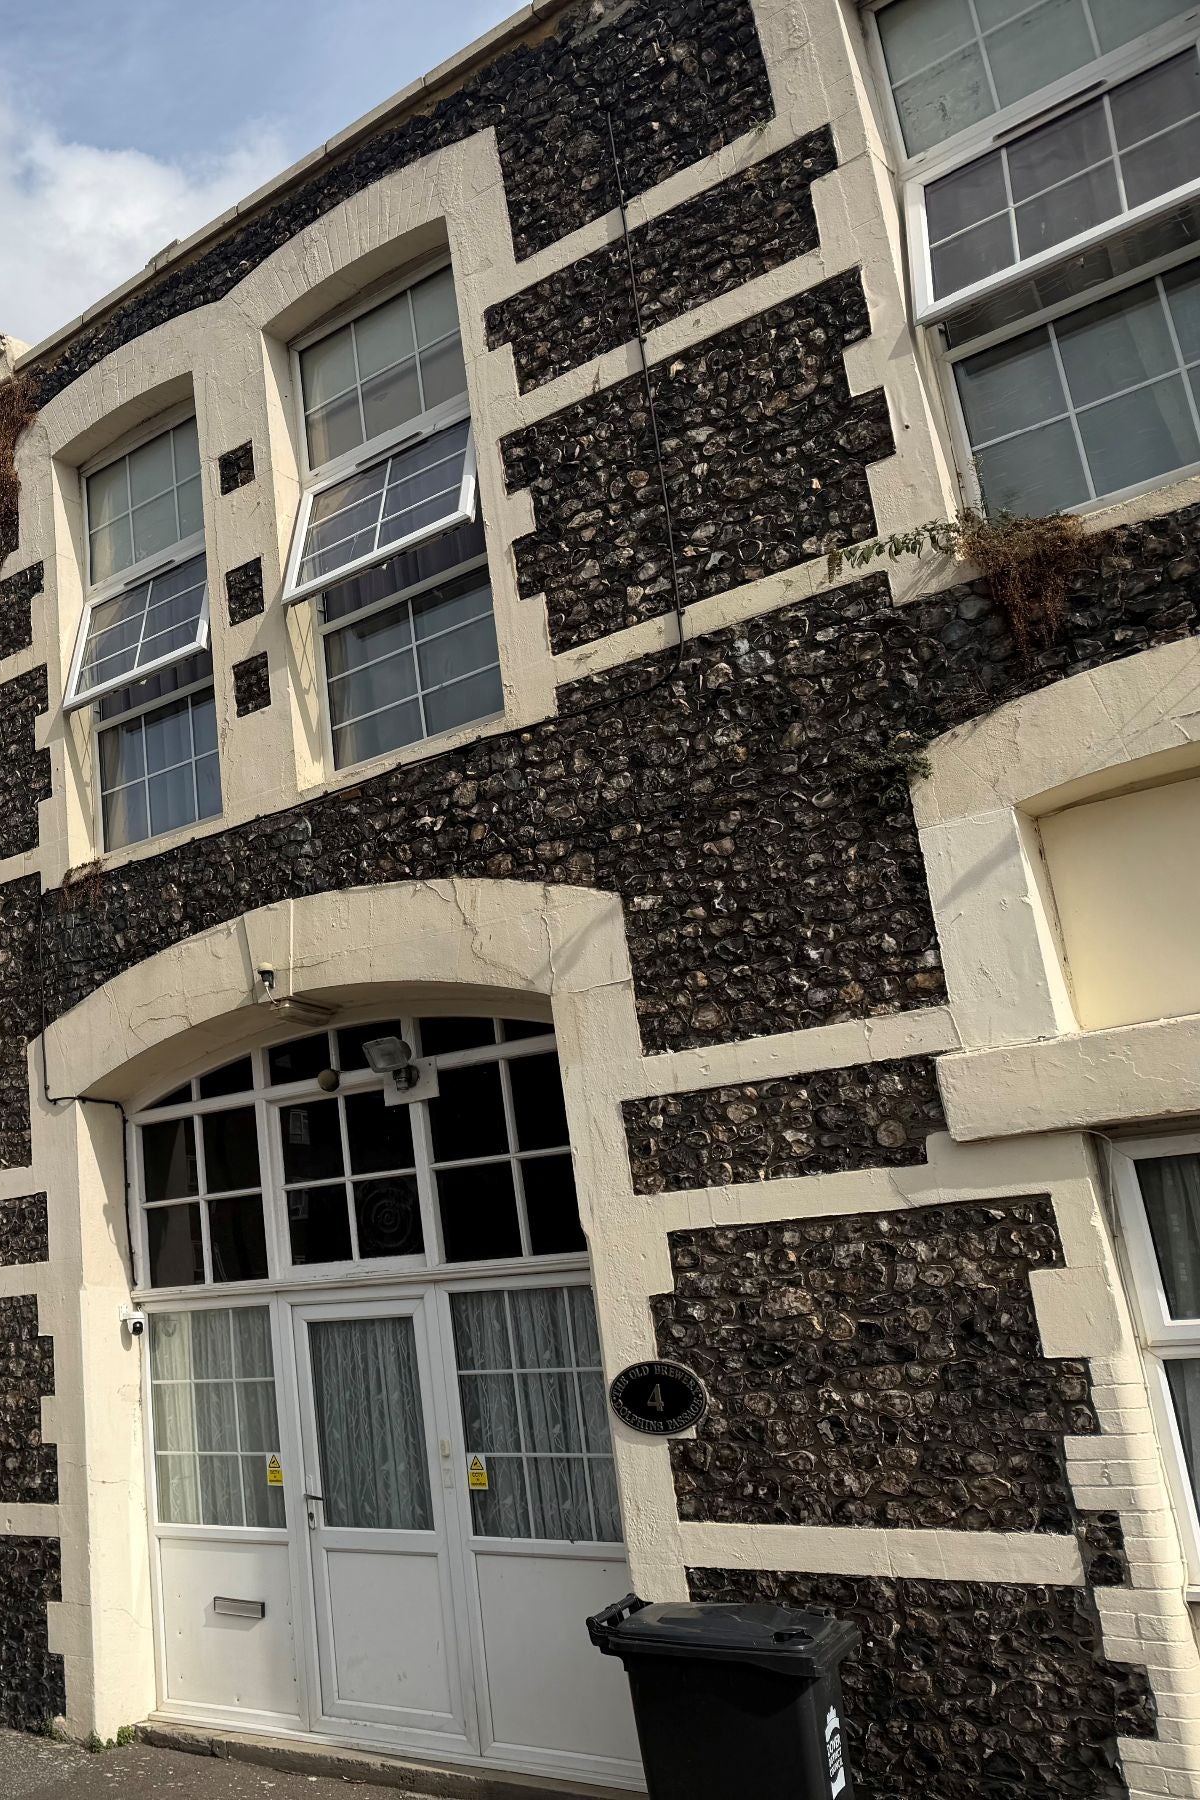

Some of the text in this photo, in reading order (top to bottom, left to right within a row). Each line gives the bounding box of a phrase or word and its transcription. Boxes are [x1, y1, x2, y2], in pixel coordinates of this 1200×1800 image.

[613, 1364, 701, 1397] THE OLD BREWERY
[613, 1396, 703, 1431] DOLPHINS PASSAGE
[647, 1383, 665, 1412] 4
